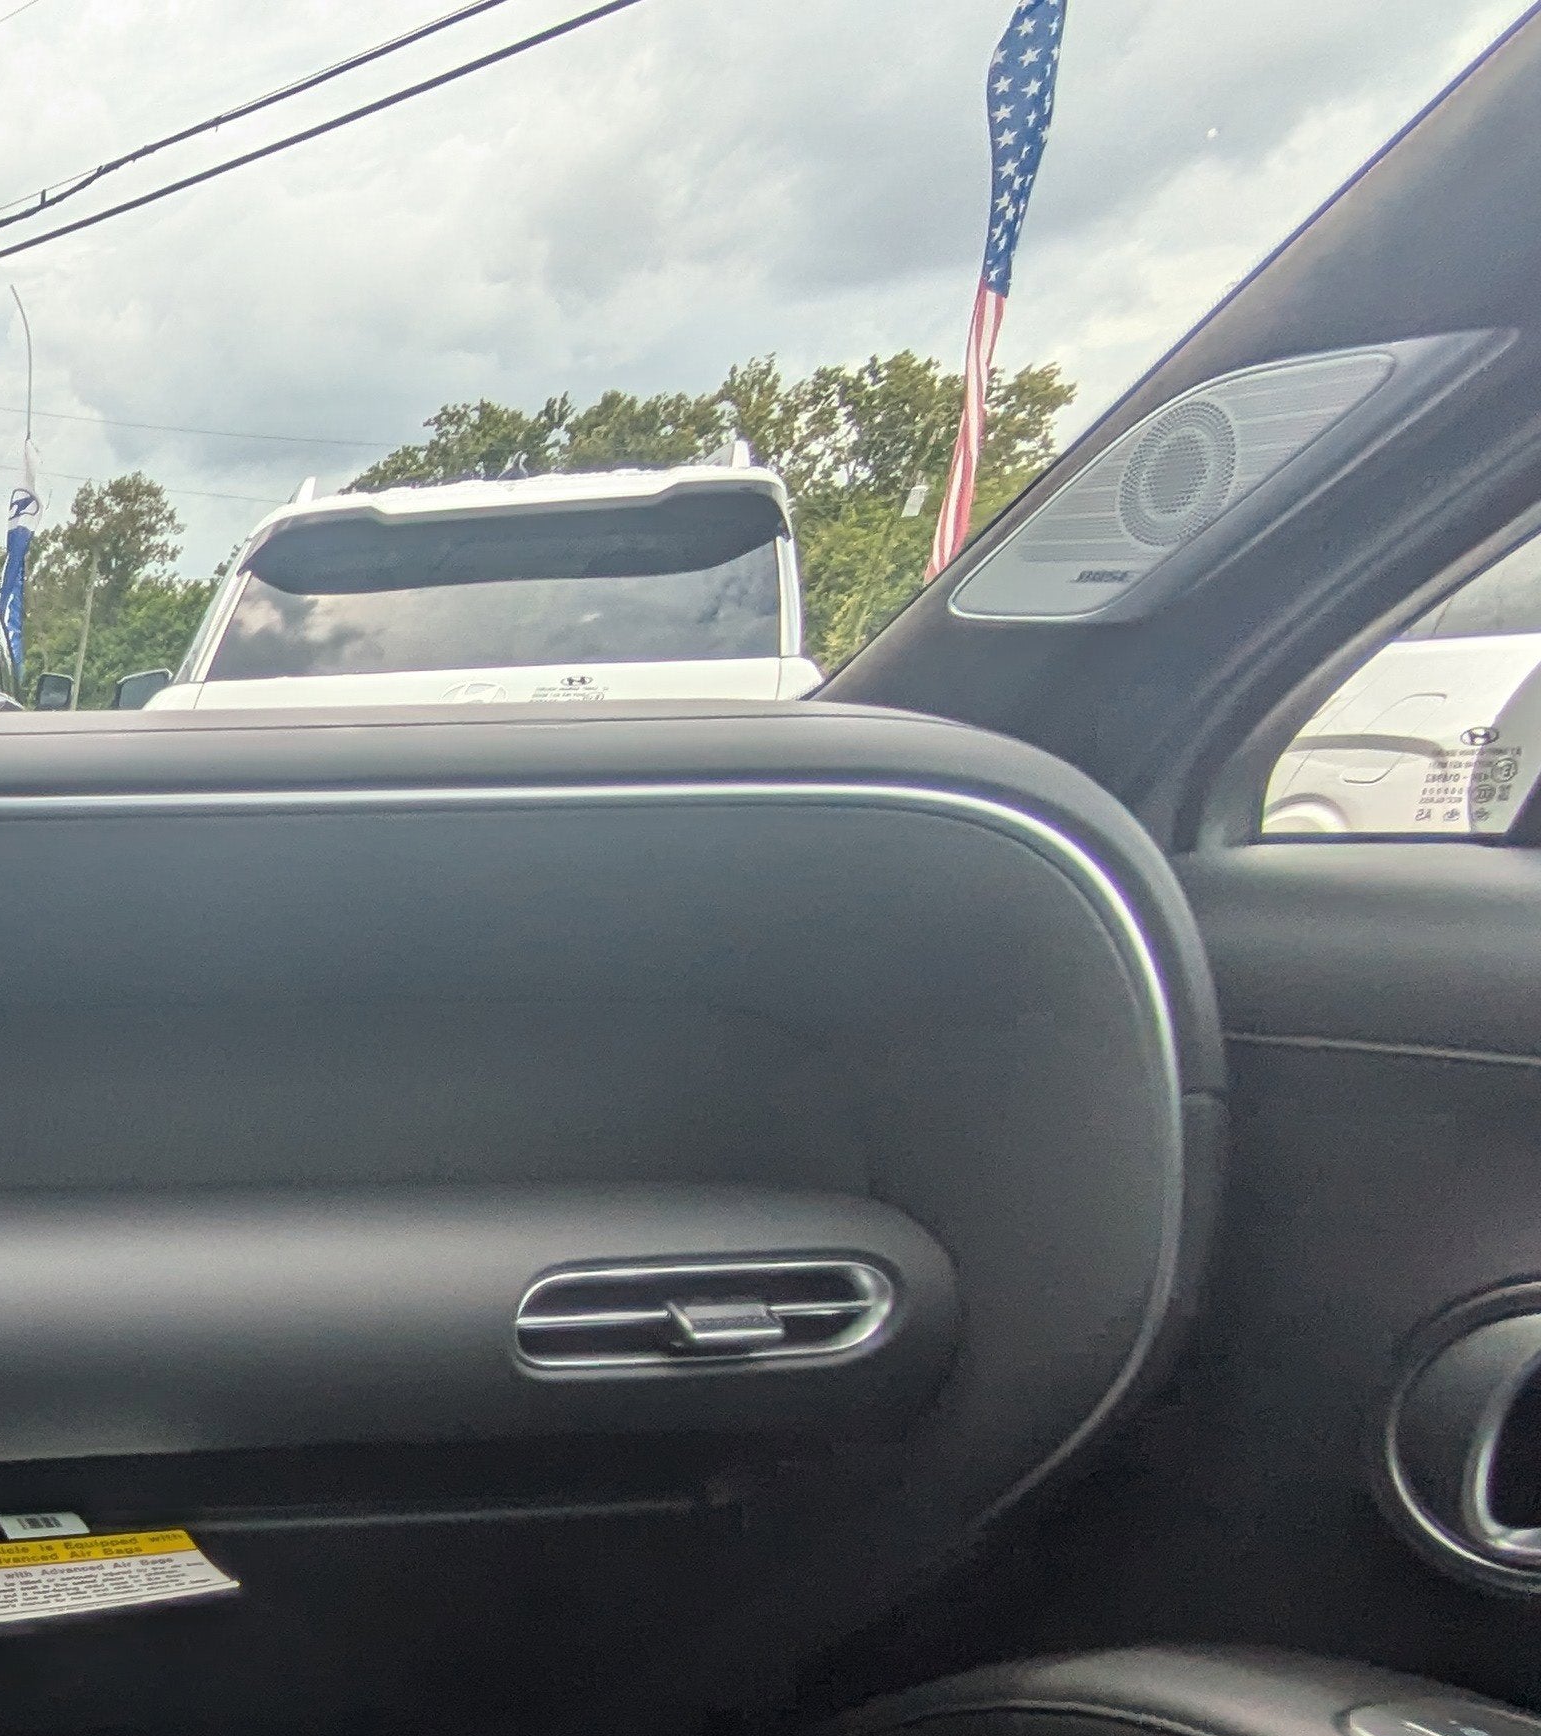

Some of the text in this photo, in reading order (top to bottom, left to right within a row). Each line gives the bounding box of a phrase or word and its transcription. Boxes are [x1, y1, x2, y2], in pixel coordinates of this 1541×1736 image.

[39, 1543, 54, 1552] is
[64, 1536, 139, 1550] Equipped
[148, 1532, 183, 1543] with
[69, 1549, 92, 1559] Air
[103, 1545, 143, 1556] Bags
[4, 1570, 33, 1580] with
[41, 1563, 105, 1577] Advanced
[113, 1560, 132, 1569] Air
[140, 1557, 174, 1566] Bags
